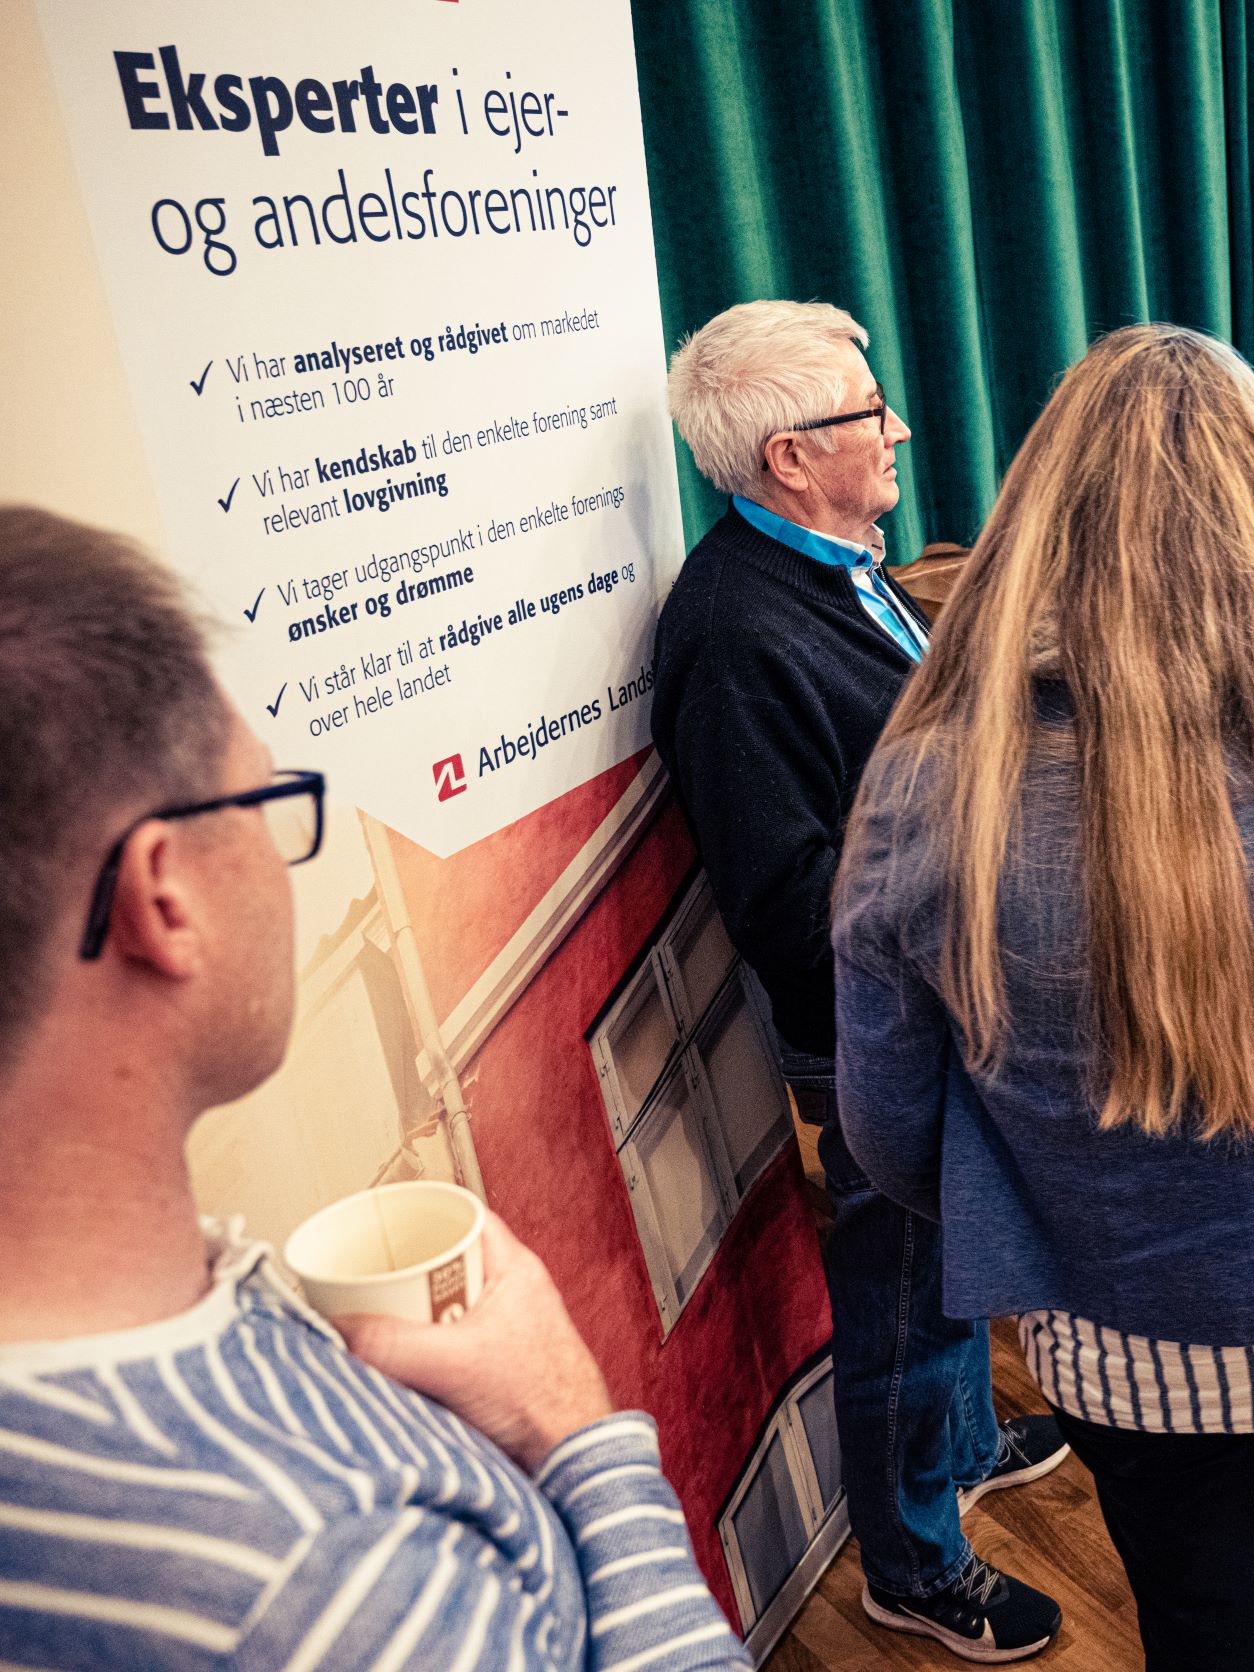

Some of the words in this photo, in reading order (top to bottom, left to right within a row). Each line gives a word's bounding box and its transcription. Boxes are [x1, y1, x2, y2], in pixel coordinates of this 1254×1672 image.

[112, 44, 439, 157] Eksperter
[452, 67, 469, 135] i
[484, 71, 569, 154] ejer-
[151, 197, 237, 277] og
[252, 168, 617, 249] andelsforeninger
[225, 355, 249, 383] Vi
[252, 352, 286, 380] har
[293, 336, 406, 374] analyseret
[410, 337, 435, 362] og
[438, 322, 509, 354] rådgivet
[512, 322, 537, 341] om
[540, 308, 600, 336] markedet
[235, 396, 244, 423] i
[250, 390, 325, 420] næsten
[332, 377, 371, 405] 100
[377, 373, 394, 398] år
[252, 469, 274, 498] Vi
[278, 466, 310, 492] har
[314, 439, 417, 485] kendskab
[421, 433, 437, 460] til
[442, 430, 473, 455] den
[477, 416, 530, 447] enkelte
[532, 405, 588, 434] forening
[589, 397, 618, 421] samt
[263, 496, 341, 535] relevant
[342, 472, 449, 514] lovgivning
[277, 579, 298, 606] Vi
[302, 569, 348, 601] tager
[354, 529, 475, 583] udgangspunkt
[477, 524, 483, 546] i
[487, 519, 516, 543] den
[519, 501, 569, 533] enkelte
[571, 486, 625, 517] forenings
[288, 602, 358, 643] ønsker
[365, 592, 392, 618] og
[396, 567, 474, 606] drømme
[299, 678, 320, 702] Vi
[324, 664, 356, 695] står
[360, 653, 392, 680] klar
[397, 640, 413, 666] til
[418, 637, 436, 659] at
[439, 614, 503, 652] rådgive
[507, 598, 536, 626] alle
[540, 583, 584, 615] ugens
[587, 570, 619, 595] dage
[621, 562, 636, 583] og
[309, 706, 349, 737] over
[353, 686, 393, 718] hele
[396, 664, 452, 701] landet
[479, 699, 602, 778] Arbejdernes
[607, 660, 657, 712] Lands
